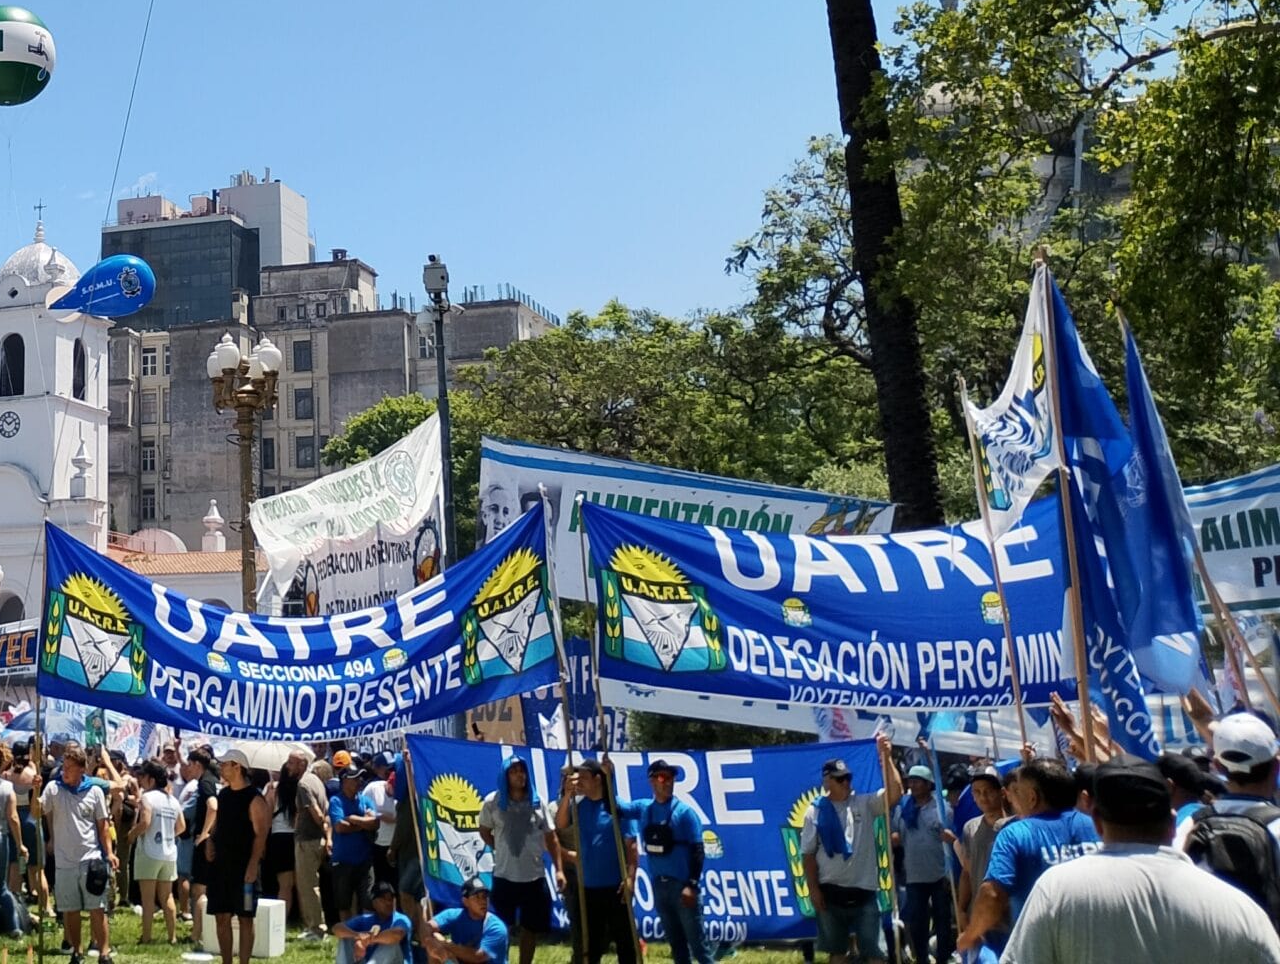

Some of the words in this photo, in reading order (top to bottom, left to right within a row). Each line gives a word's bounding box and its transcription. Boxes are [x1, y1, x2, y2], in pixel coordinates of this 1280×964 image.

[704, 520, 1054, 594] UATRE
[151, 573, 454, 661] UATRE
[149, 657, 317, 729] PERGAMINO
[322, 644, 462, 728] PRESENTE
[236, 661, 342, 683] SECCIONAL
[343, 657, 376, 679] 494
[726, 629, 910, 691] DELEGACIÓN
[917, 629, 1065, 691] PERGAMIN
